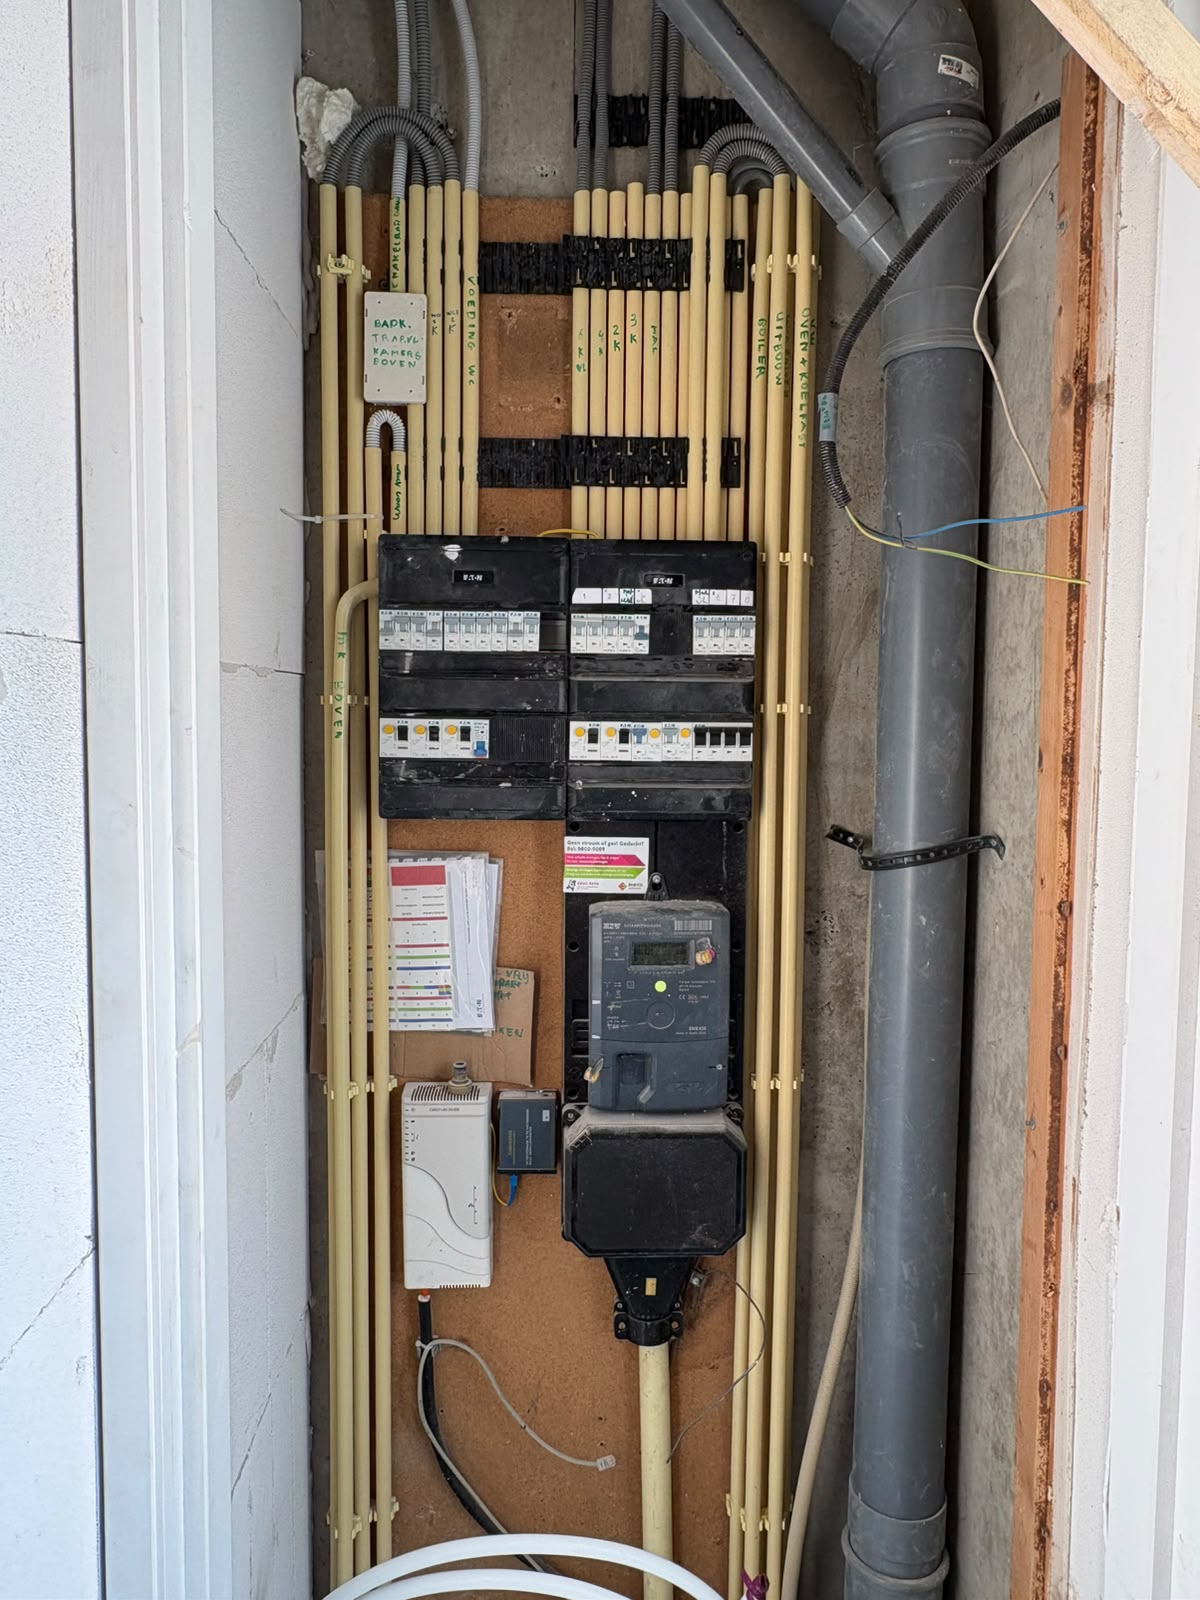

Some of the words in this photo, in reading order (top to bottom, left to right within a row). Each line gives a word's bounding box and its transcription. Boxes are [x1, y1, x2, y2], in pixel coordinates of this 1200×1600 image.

[466, 275, 477, 351] VOEDING
[630, 313, 638, 327] 3
[612, 324, 620, 336] 2
[799, 307, 811, 352] OVEN
[613, 339, 621, 352] K
[630, 333, 638, 344] K
[372, 347, 422, 361] KAMERS
[755, 318, 767, 379] BOILER
[773, 312, 784, 386] UITBOUW
[373, 357, 417, 368] BOVEN
